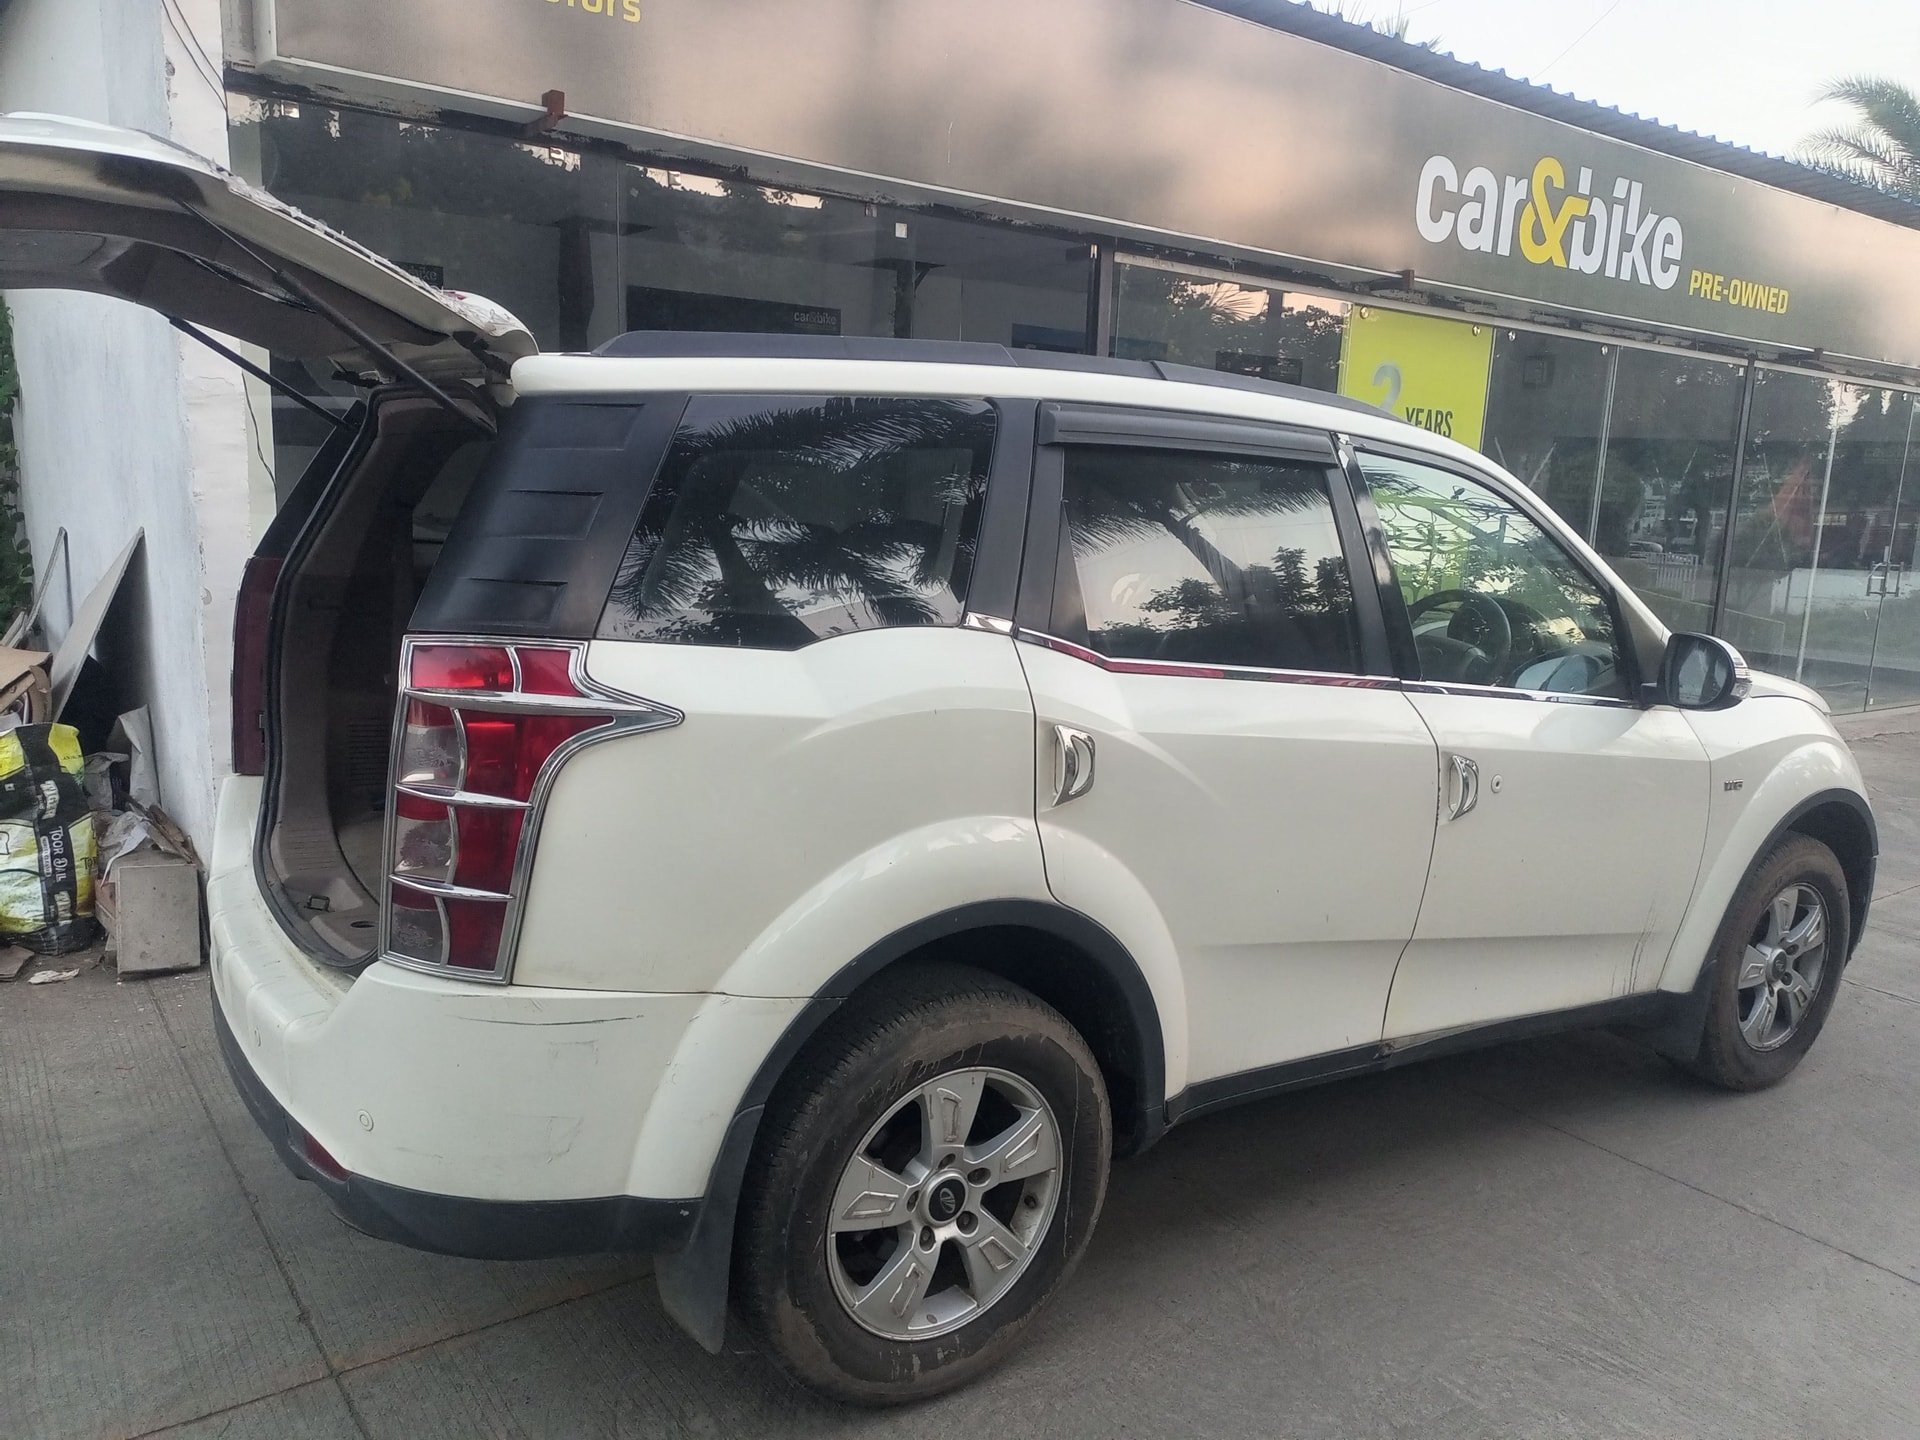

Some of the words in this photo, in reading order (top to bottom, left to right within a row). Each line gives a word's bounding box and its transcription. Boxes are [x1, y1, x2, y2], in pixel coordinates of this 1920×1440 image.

[545, 0, 641, 22] ors
[1415, 155, 1683, 290] car&bike
[1688, 269, 1789, 314] PRE-OWNED
[1371, 361, 1402, 412] 2
[1405, 406, 1453, 438] YEARS
[49, 825, 64, 855] TOOR
